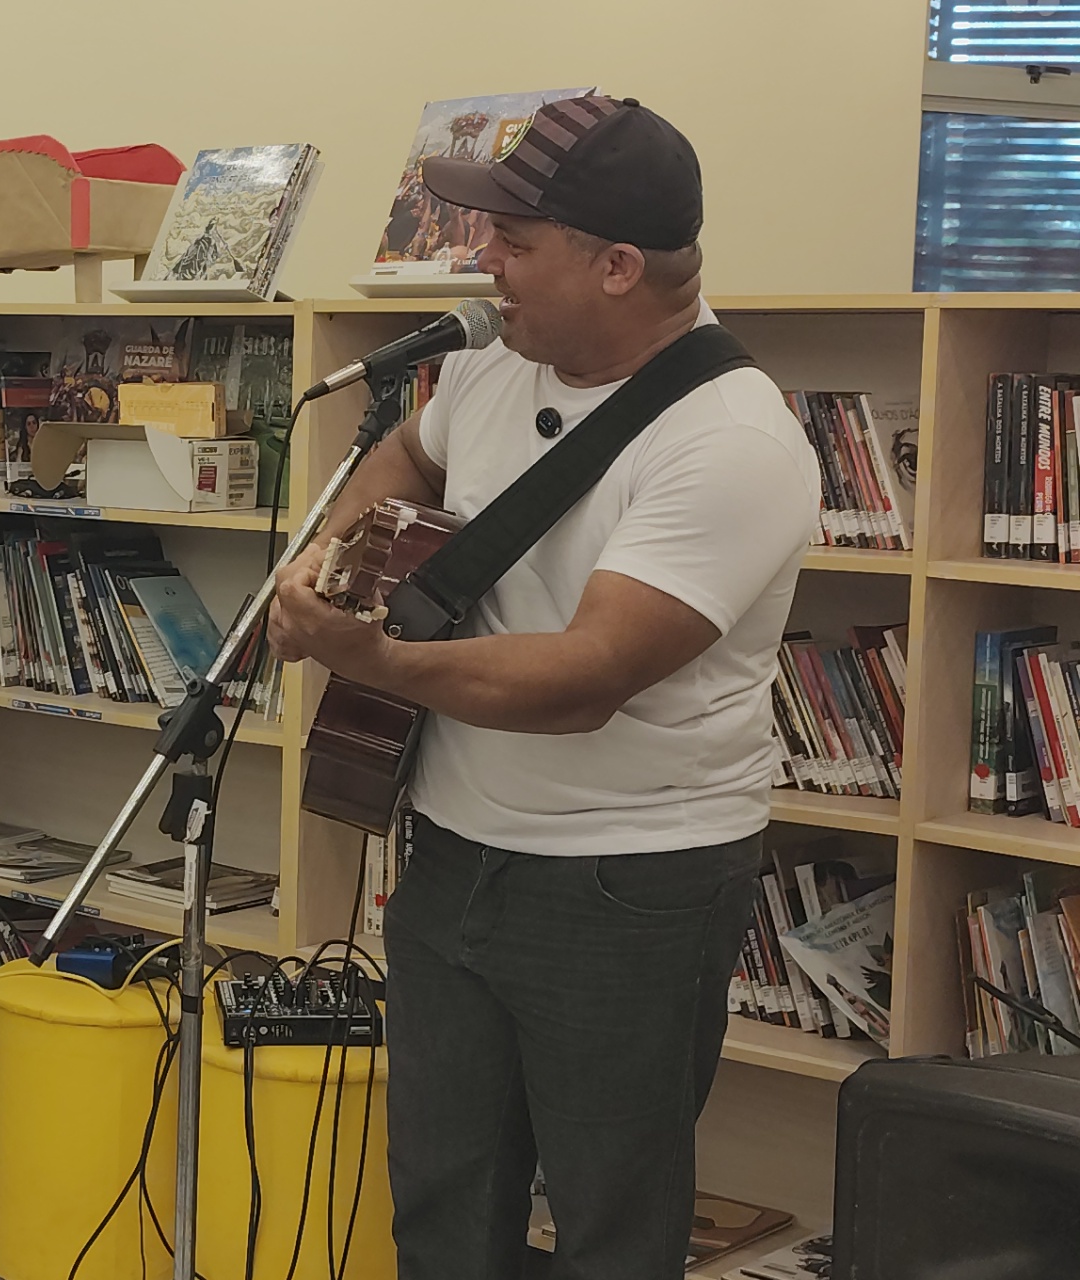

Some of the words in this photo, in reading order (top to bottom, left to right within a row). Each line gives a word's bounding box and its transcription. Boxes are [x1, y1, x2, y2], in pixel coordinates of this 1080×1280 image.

[124, 354, 173, 368] NAZARÉ
[125, 345, 160, 355] GUARDA
[162, 345, 175, 355] DE
[1037, 385, 1051, 421] ENTRE
[1037, 422, 1051, 471] MUNDOS
